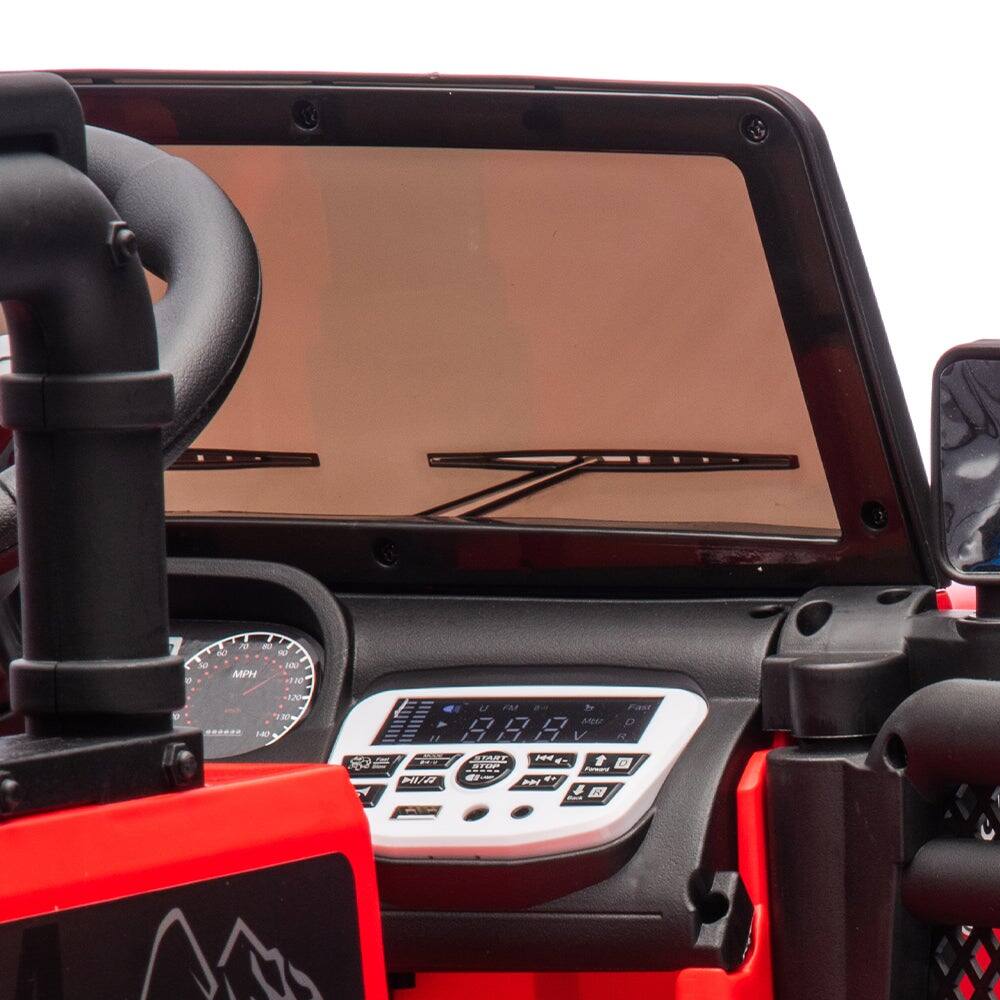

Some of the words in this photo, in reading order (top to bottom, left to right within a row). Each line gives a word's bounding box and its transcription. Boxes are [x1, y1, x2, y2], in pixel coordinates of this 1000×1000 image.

[216, 649, 228, 657] 60
[232, 669, 258, 679] MPH
[275, 713, 290, 721] 130
[255, 730, 270, 738] 140
